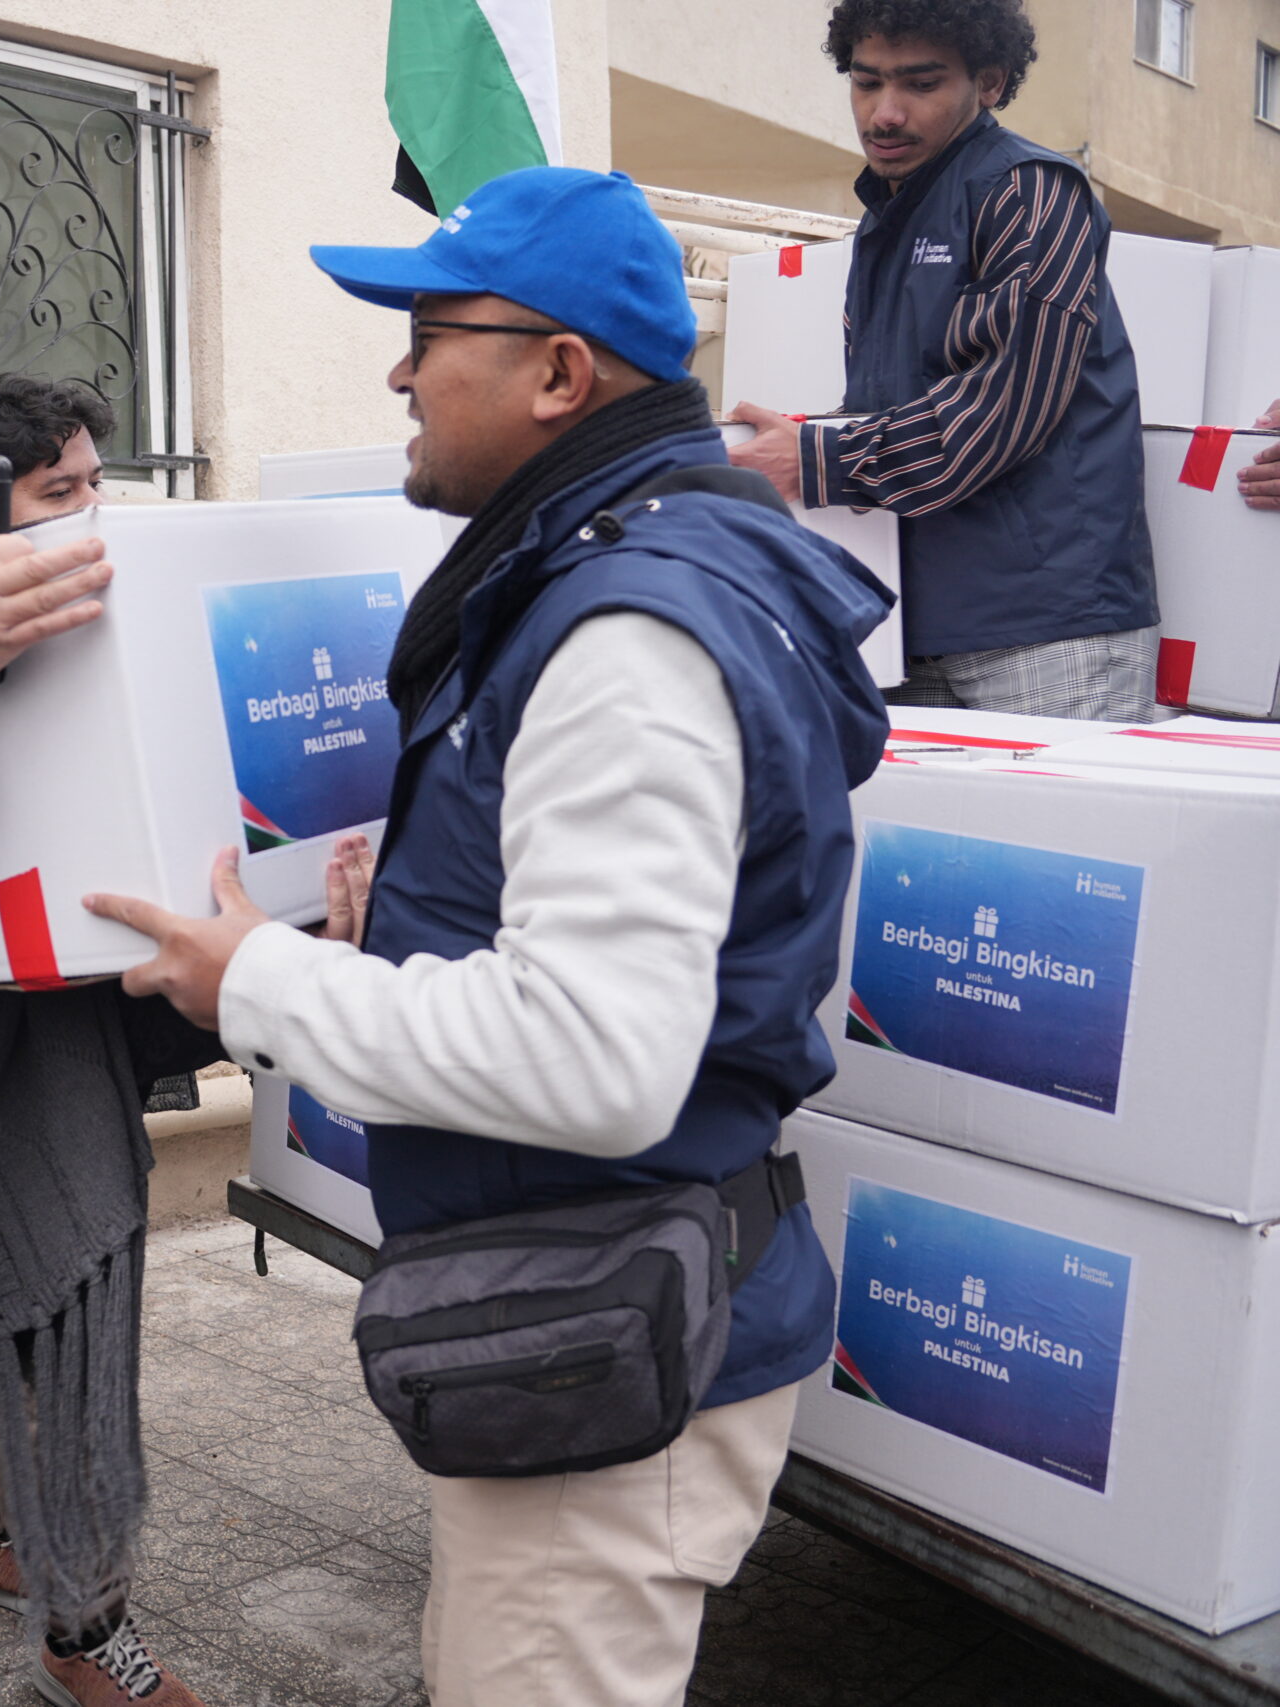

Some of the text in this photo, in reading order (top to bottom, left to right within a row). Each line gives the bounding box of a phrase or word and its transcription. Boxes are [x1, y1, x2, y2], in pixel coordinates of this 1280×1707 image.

[246, 676, 388, 723] Berbagi Bingkisa
[322, 717, 343, 730] untuk
[303, 728, 367, 755] PALESTINA
[882, 920, 1095, 989] Berbagi Bingkisan
[965, 970, 993, 985] untuk
[935, 977, 1021, 1012] PALESTINA
[326, 1109, 365, 1136] PALESTINA
[869, 1278, 1084, 1370] Berbagi Bingkisan
[954, 1337, 982, 1354] untuk
[923, 1340, 1010, 1383] PALESTINA
